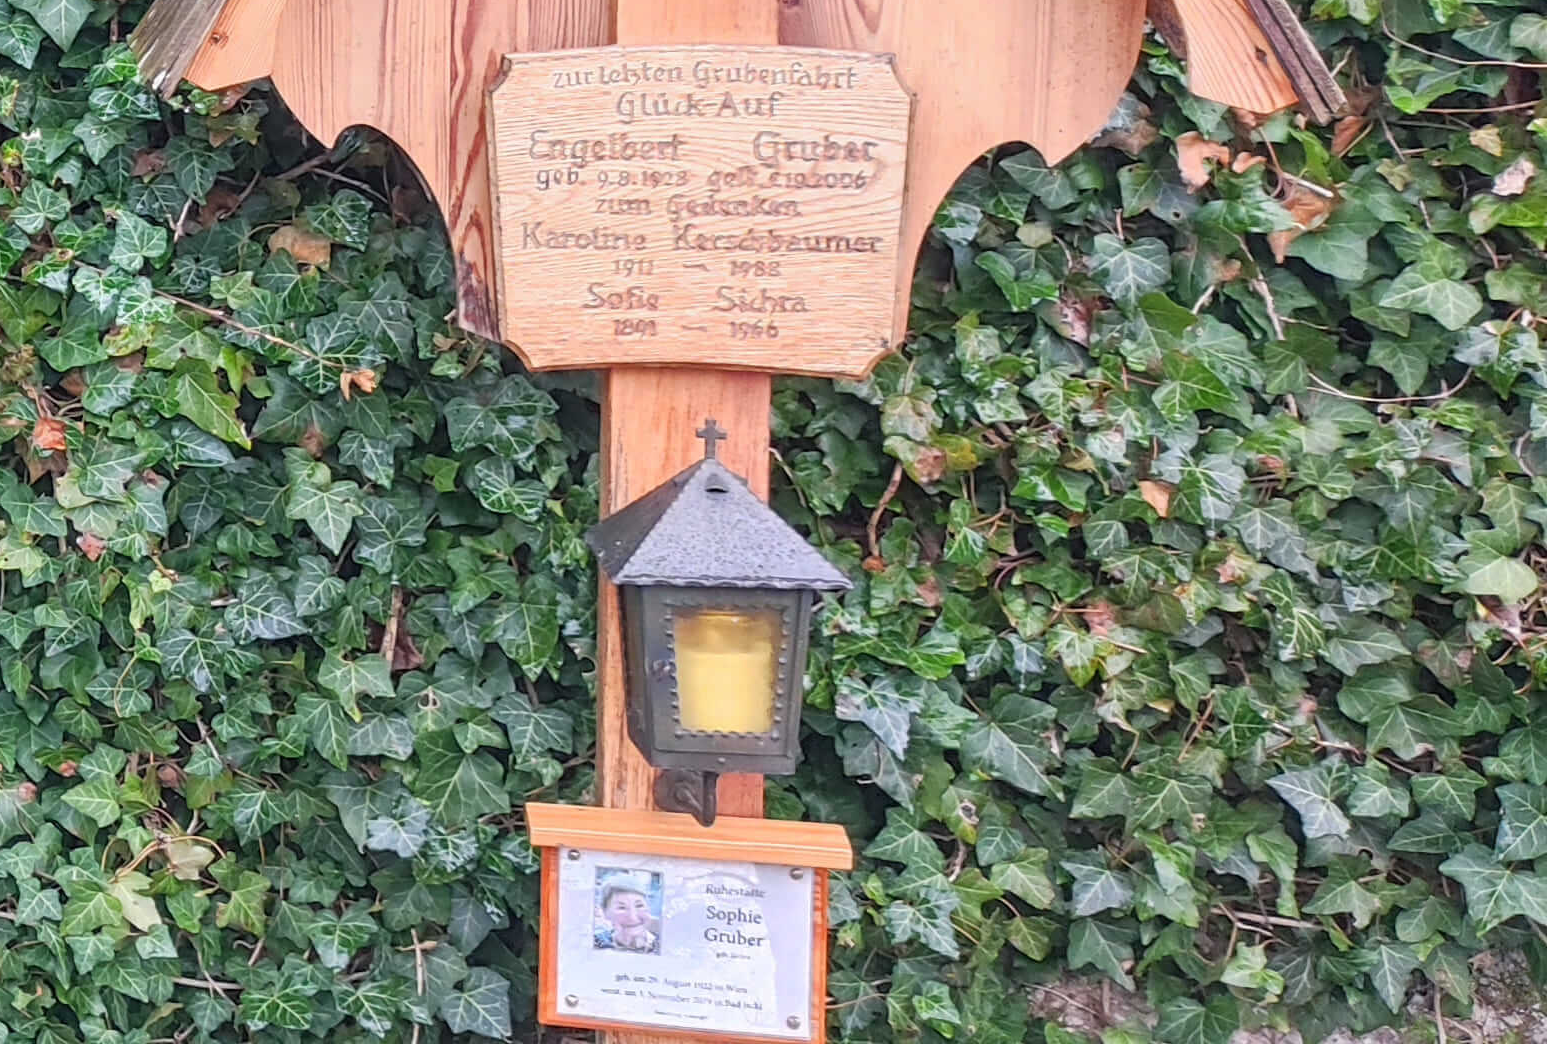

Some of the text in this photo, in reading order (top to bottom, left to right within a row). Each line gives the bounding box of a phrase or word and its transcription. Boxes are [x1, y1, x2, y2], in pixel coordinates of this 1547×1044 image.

[552, 69, 594, 88] zur
[529, 130, 879, 168] Engelbert Gruber
[593, 194, 802, 223] zum Gedenken
[521, 221, 648, 251] Karoline
[580, 282, 659, 311] Sofie
[706, 905, 763, 926] Sophie
[703, 927, 766, 948] Gruber
